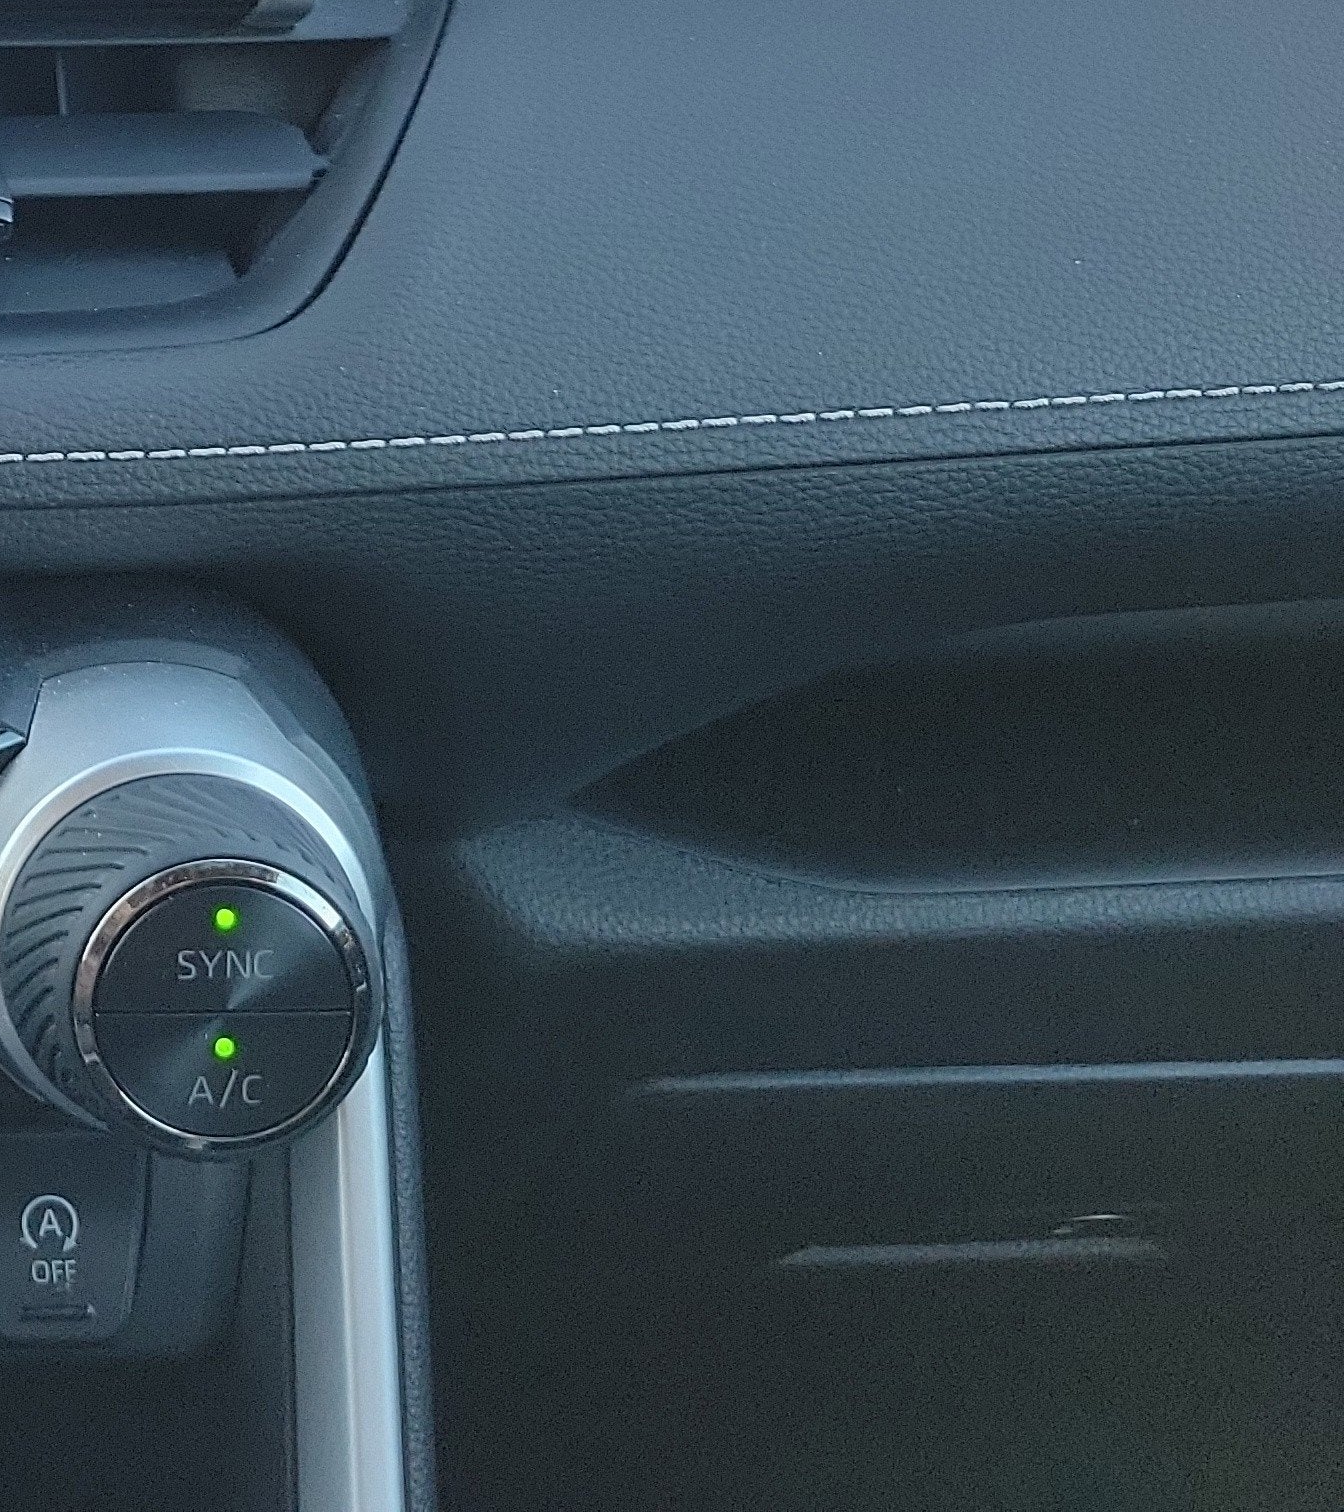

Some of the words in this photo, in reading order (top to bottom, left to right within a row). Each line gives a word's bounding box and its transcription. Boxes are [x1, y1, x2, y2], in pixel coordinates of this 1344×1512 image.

[176, 949, 273, 984] SYNC
[187, 1069, 262, 1110] A/C
[31, 1259, 77, 1284] OFF
